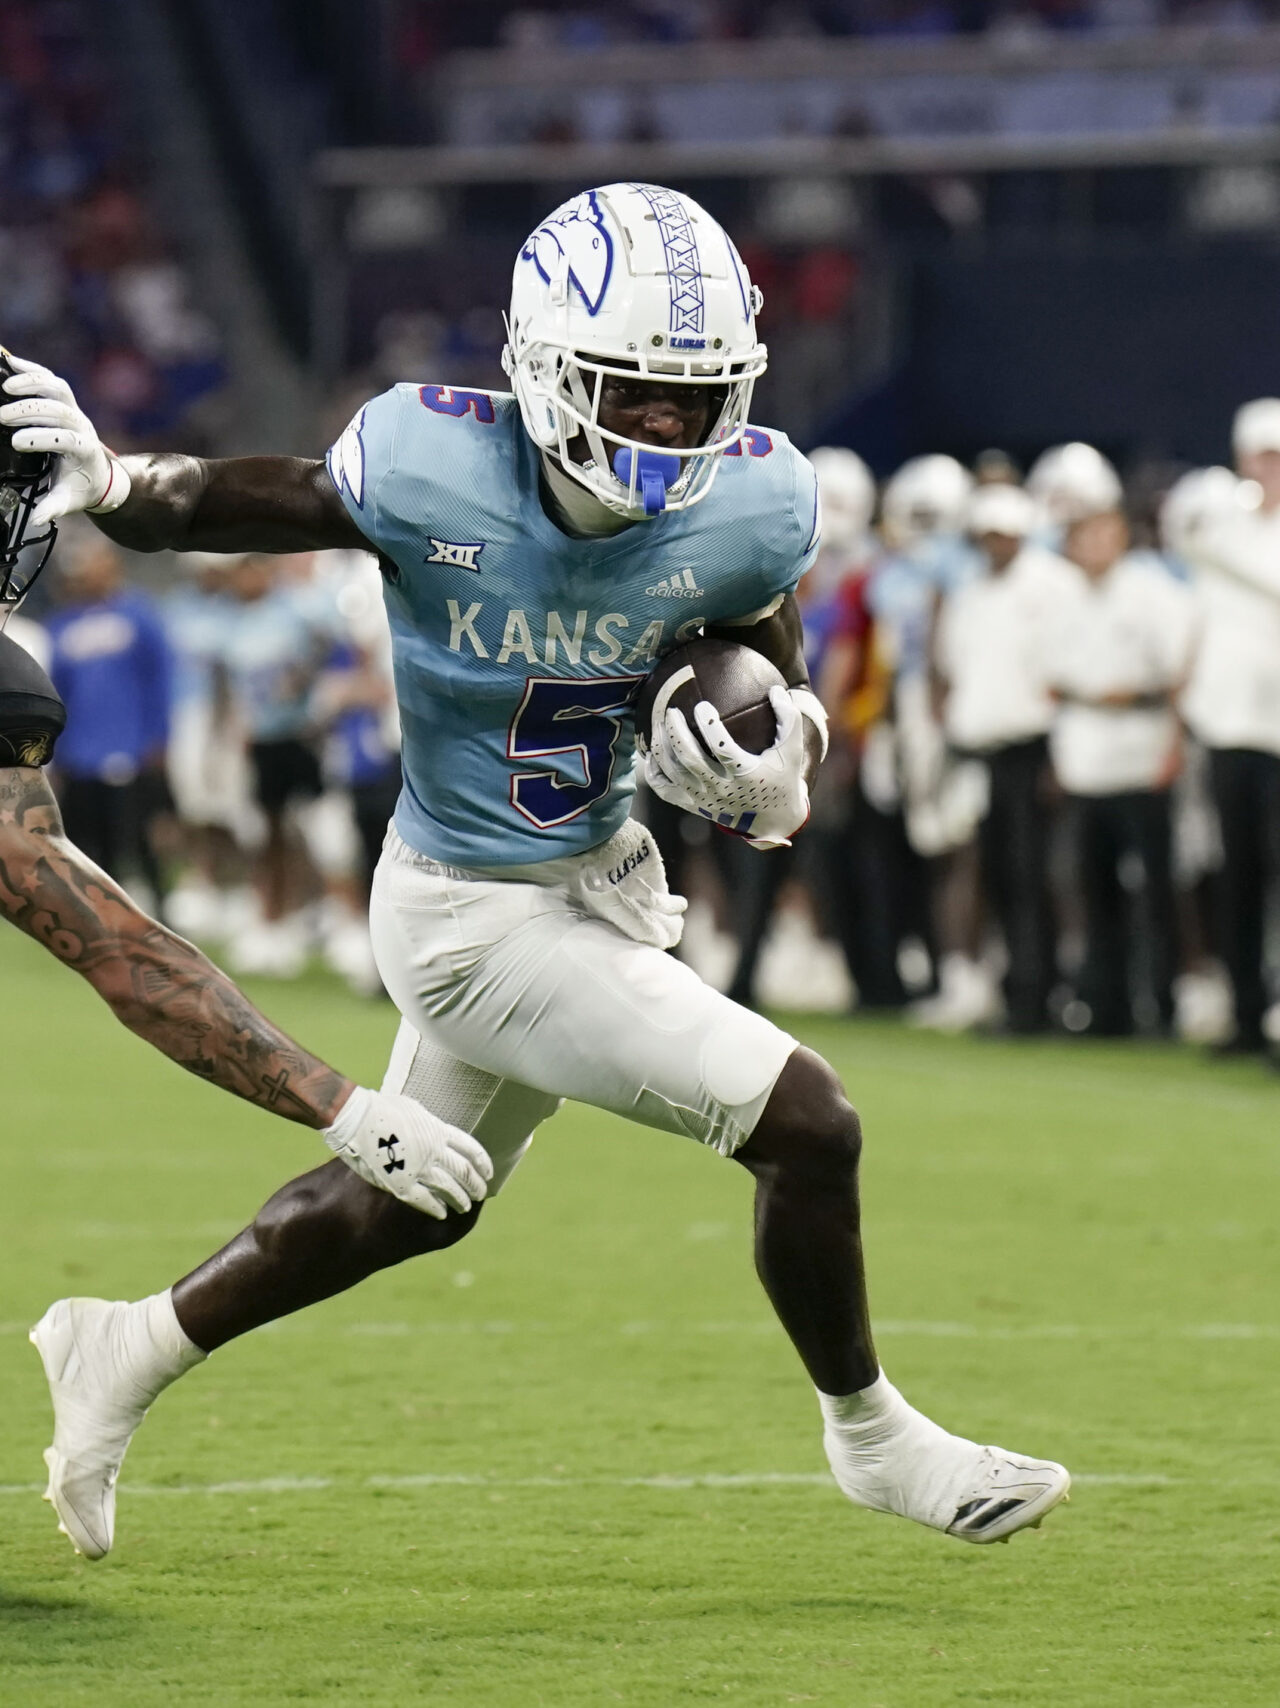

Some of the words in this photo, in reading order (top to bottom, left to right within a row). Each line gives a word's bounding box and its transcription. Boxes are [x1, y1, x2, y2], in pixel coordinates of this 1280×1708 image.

[669, 337, 706, 349] KANSAS
[418, 385, 495, 424] 5
[645, 583, 705, 599] adidas
[506, 673, 648, 829] 5
